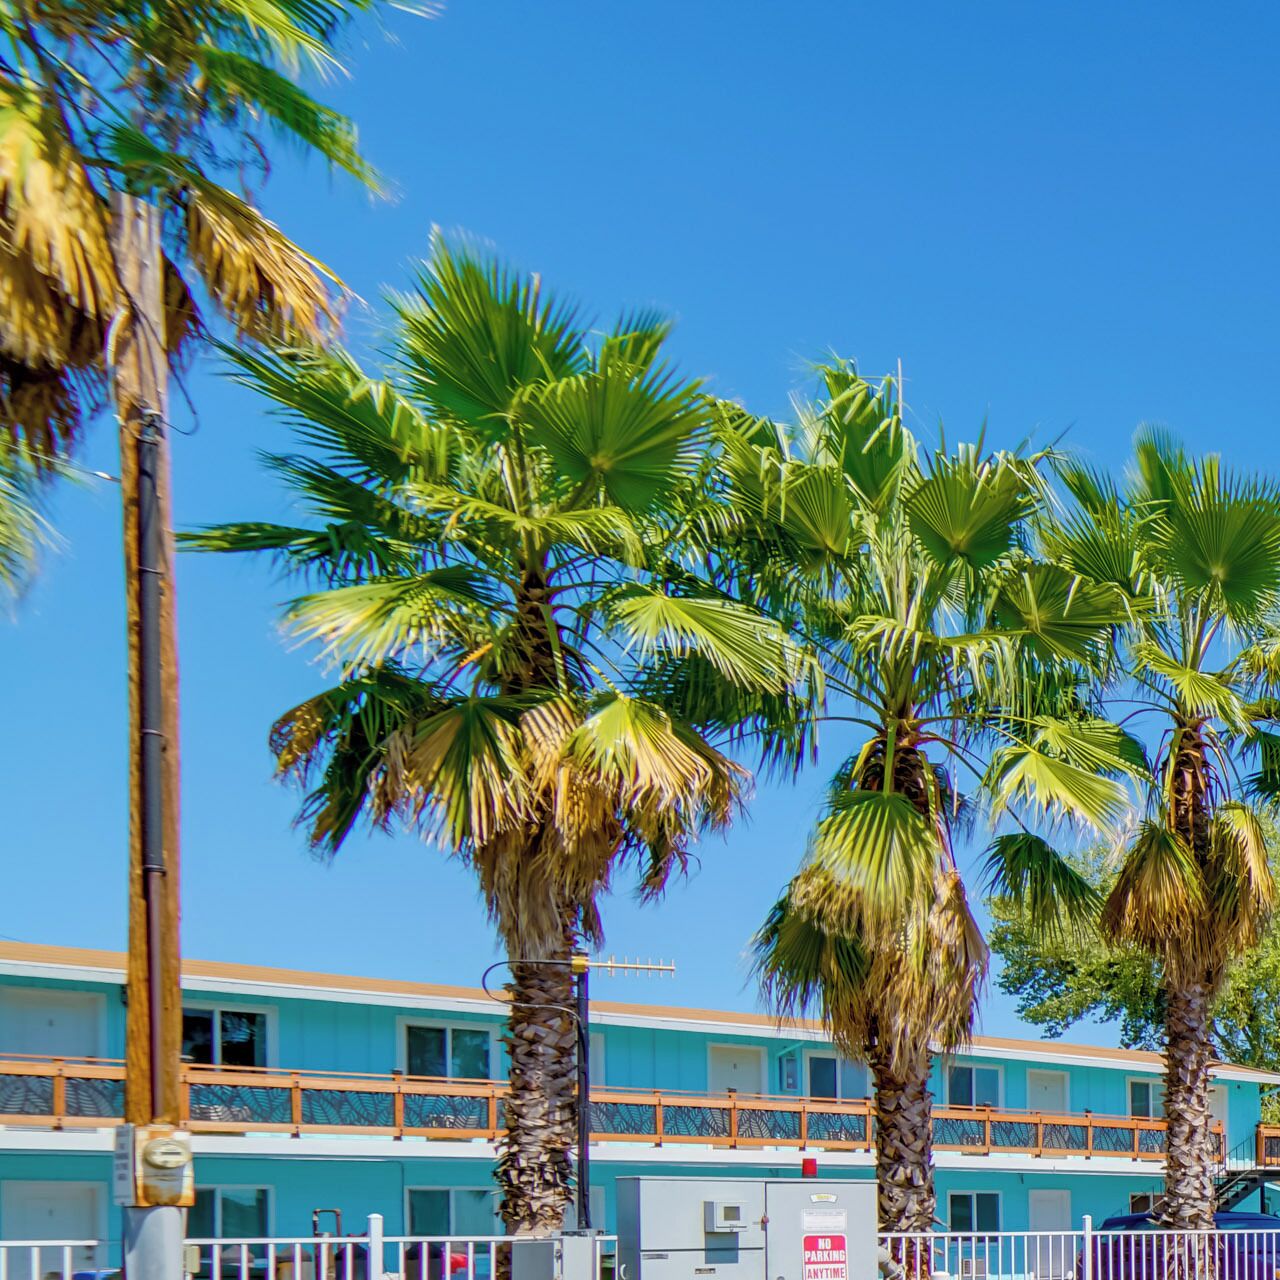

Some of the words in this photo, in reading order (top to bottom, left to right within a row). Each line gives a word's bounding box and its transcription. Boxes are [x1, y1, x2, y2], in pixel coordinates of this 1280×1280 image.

[818, 1238, 832, 1249] NO
[805, 1250, 845, 1262] PARKING
[807, 1267, 845, 1279] ANYTIME
